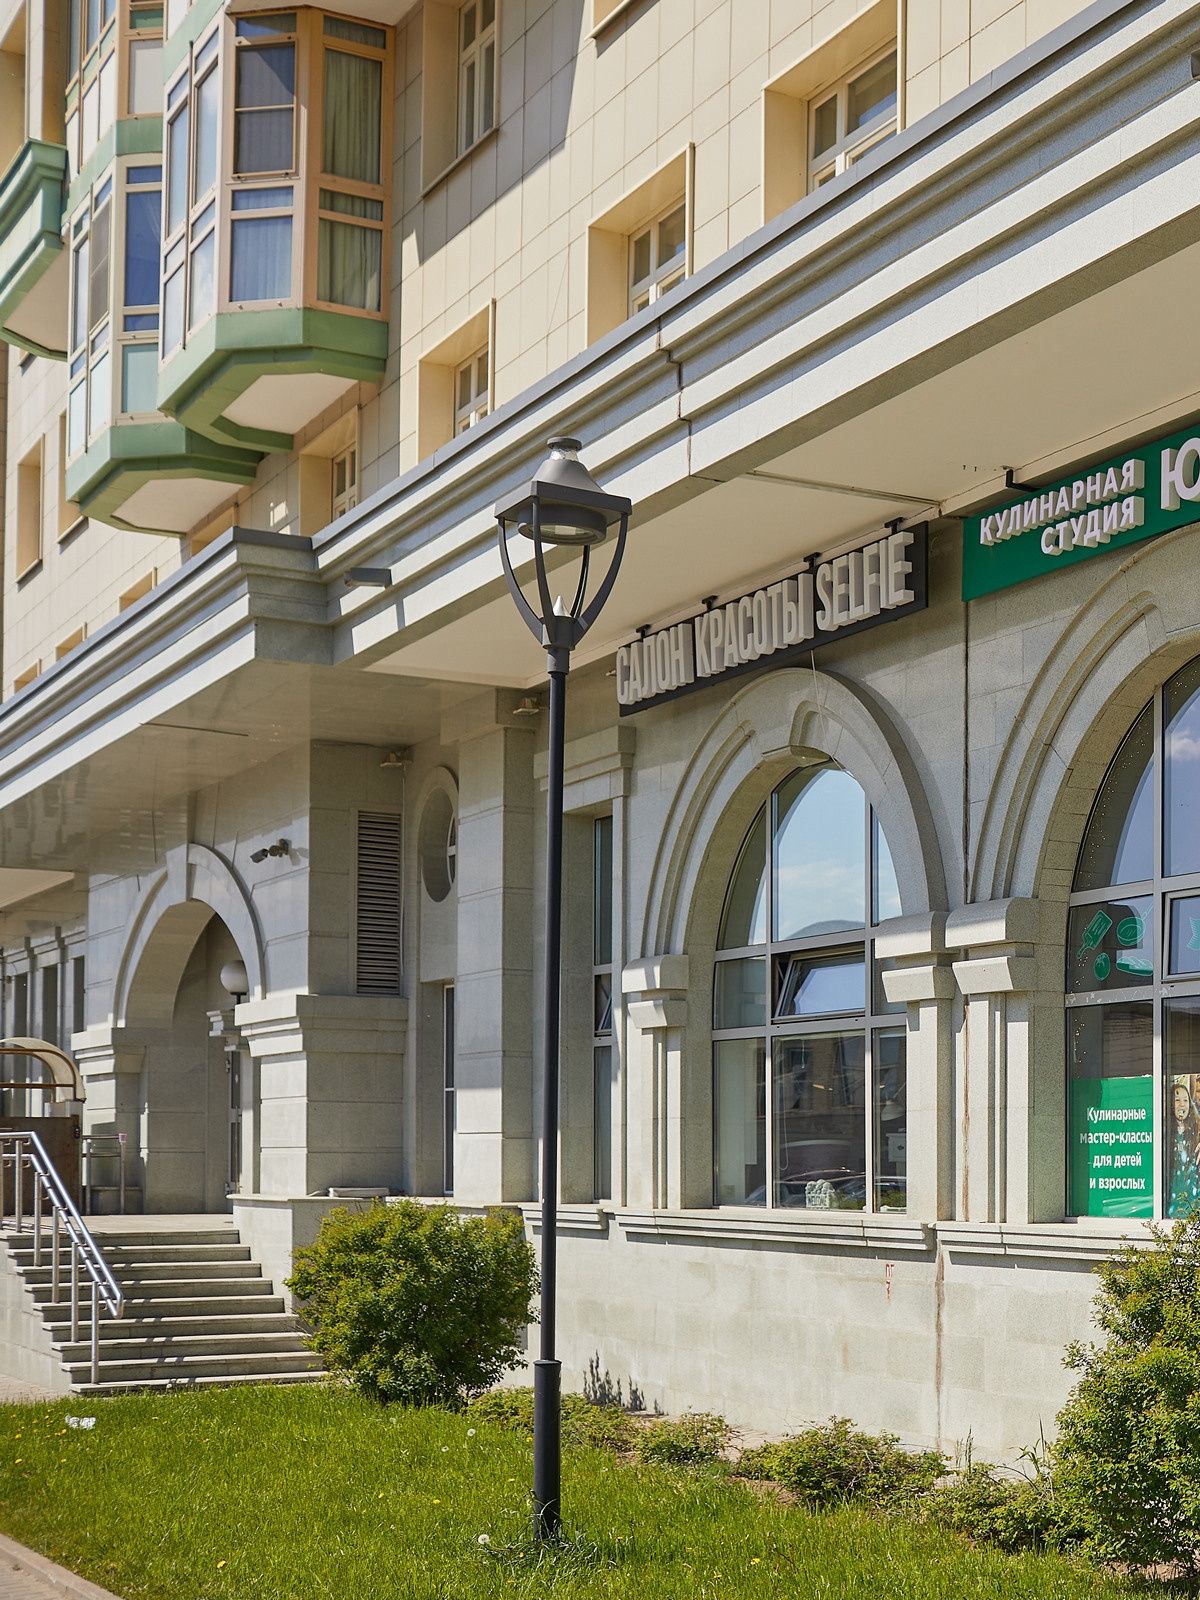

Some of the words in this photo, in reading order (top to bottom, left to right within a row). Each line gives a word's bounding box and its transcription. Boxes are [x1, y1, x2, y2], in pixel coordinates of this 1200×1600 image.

[980, 458, 1145, 546] КУЛИНАРНАЯ
[1041, 496, 1145, 556] СТУДИЯ
[616, 622, 695, 705] САЛОН
[695, 573, 815, 677] КРАСОТЫ
[816, 531, 914, 631] SELFIE
[1087, 1107, 1146, 1124] Кулинарные
[1080, 1132, 1152, 1146] мастер-классы
[1093, 1155, 1112, 1168] для
[1114, 1152, 1142, 1168] детей
[1089, 1178, 1096, 1189] и
[1098, 1178, 1146, 1192] взрослых
